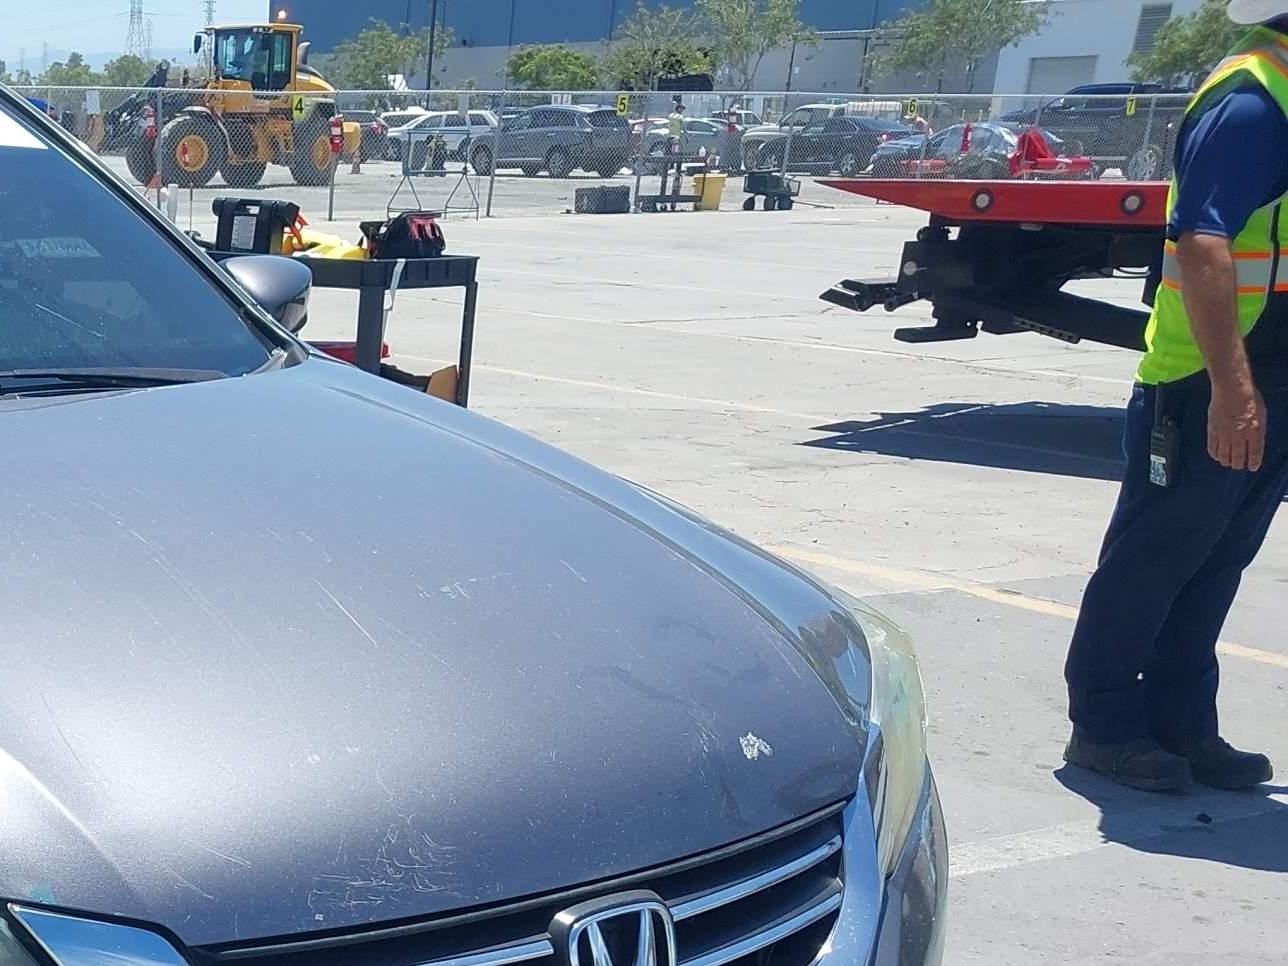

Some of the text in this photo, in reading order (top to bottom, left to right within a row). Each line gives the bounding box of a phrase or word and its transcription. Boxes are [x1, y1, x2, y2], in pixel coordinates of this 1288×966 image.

[294, 97, 304, 114] 4
[618, 97, 627, 112] 5
[909, 99, 916, 113] 6
[1128, 99, 1135, 113] 7
